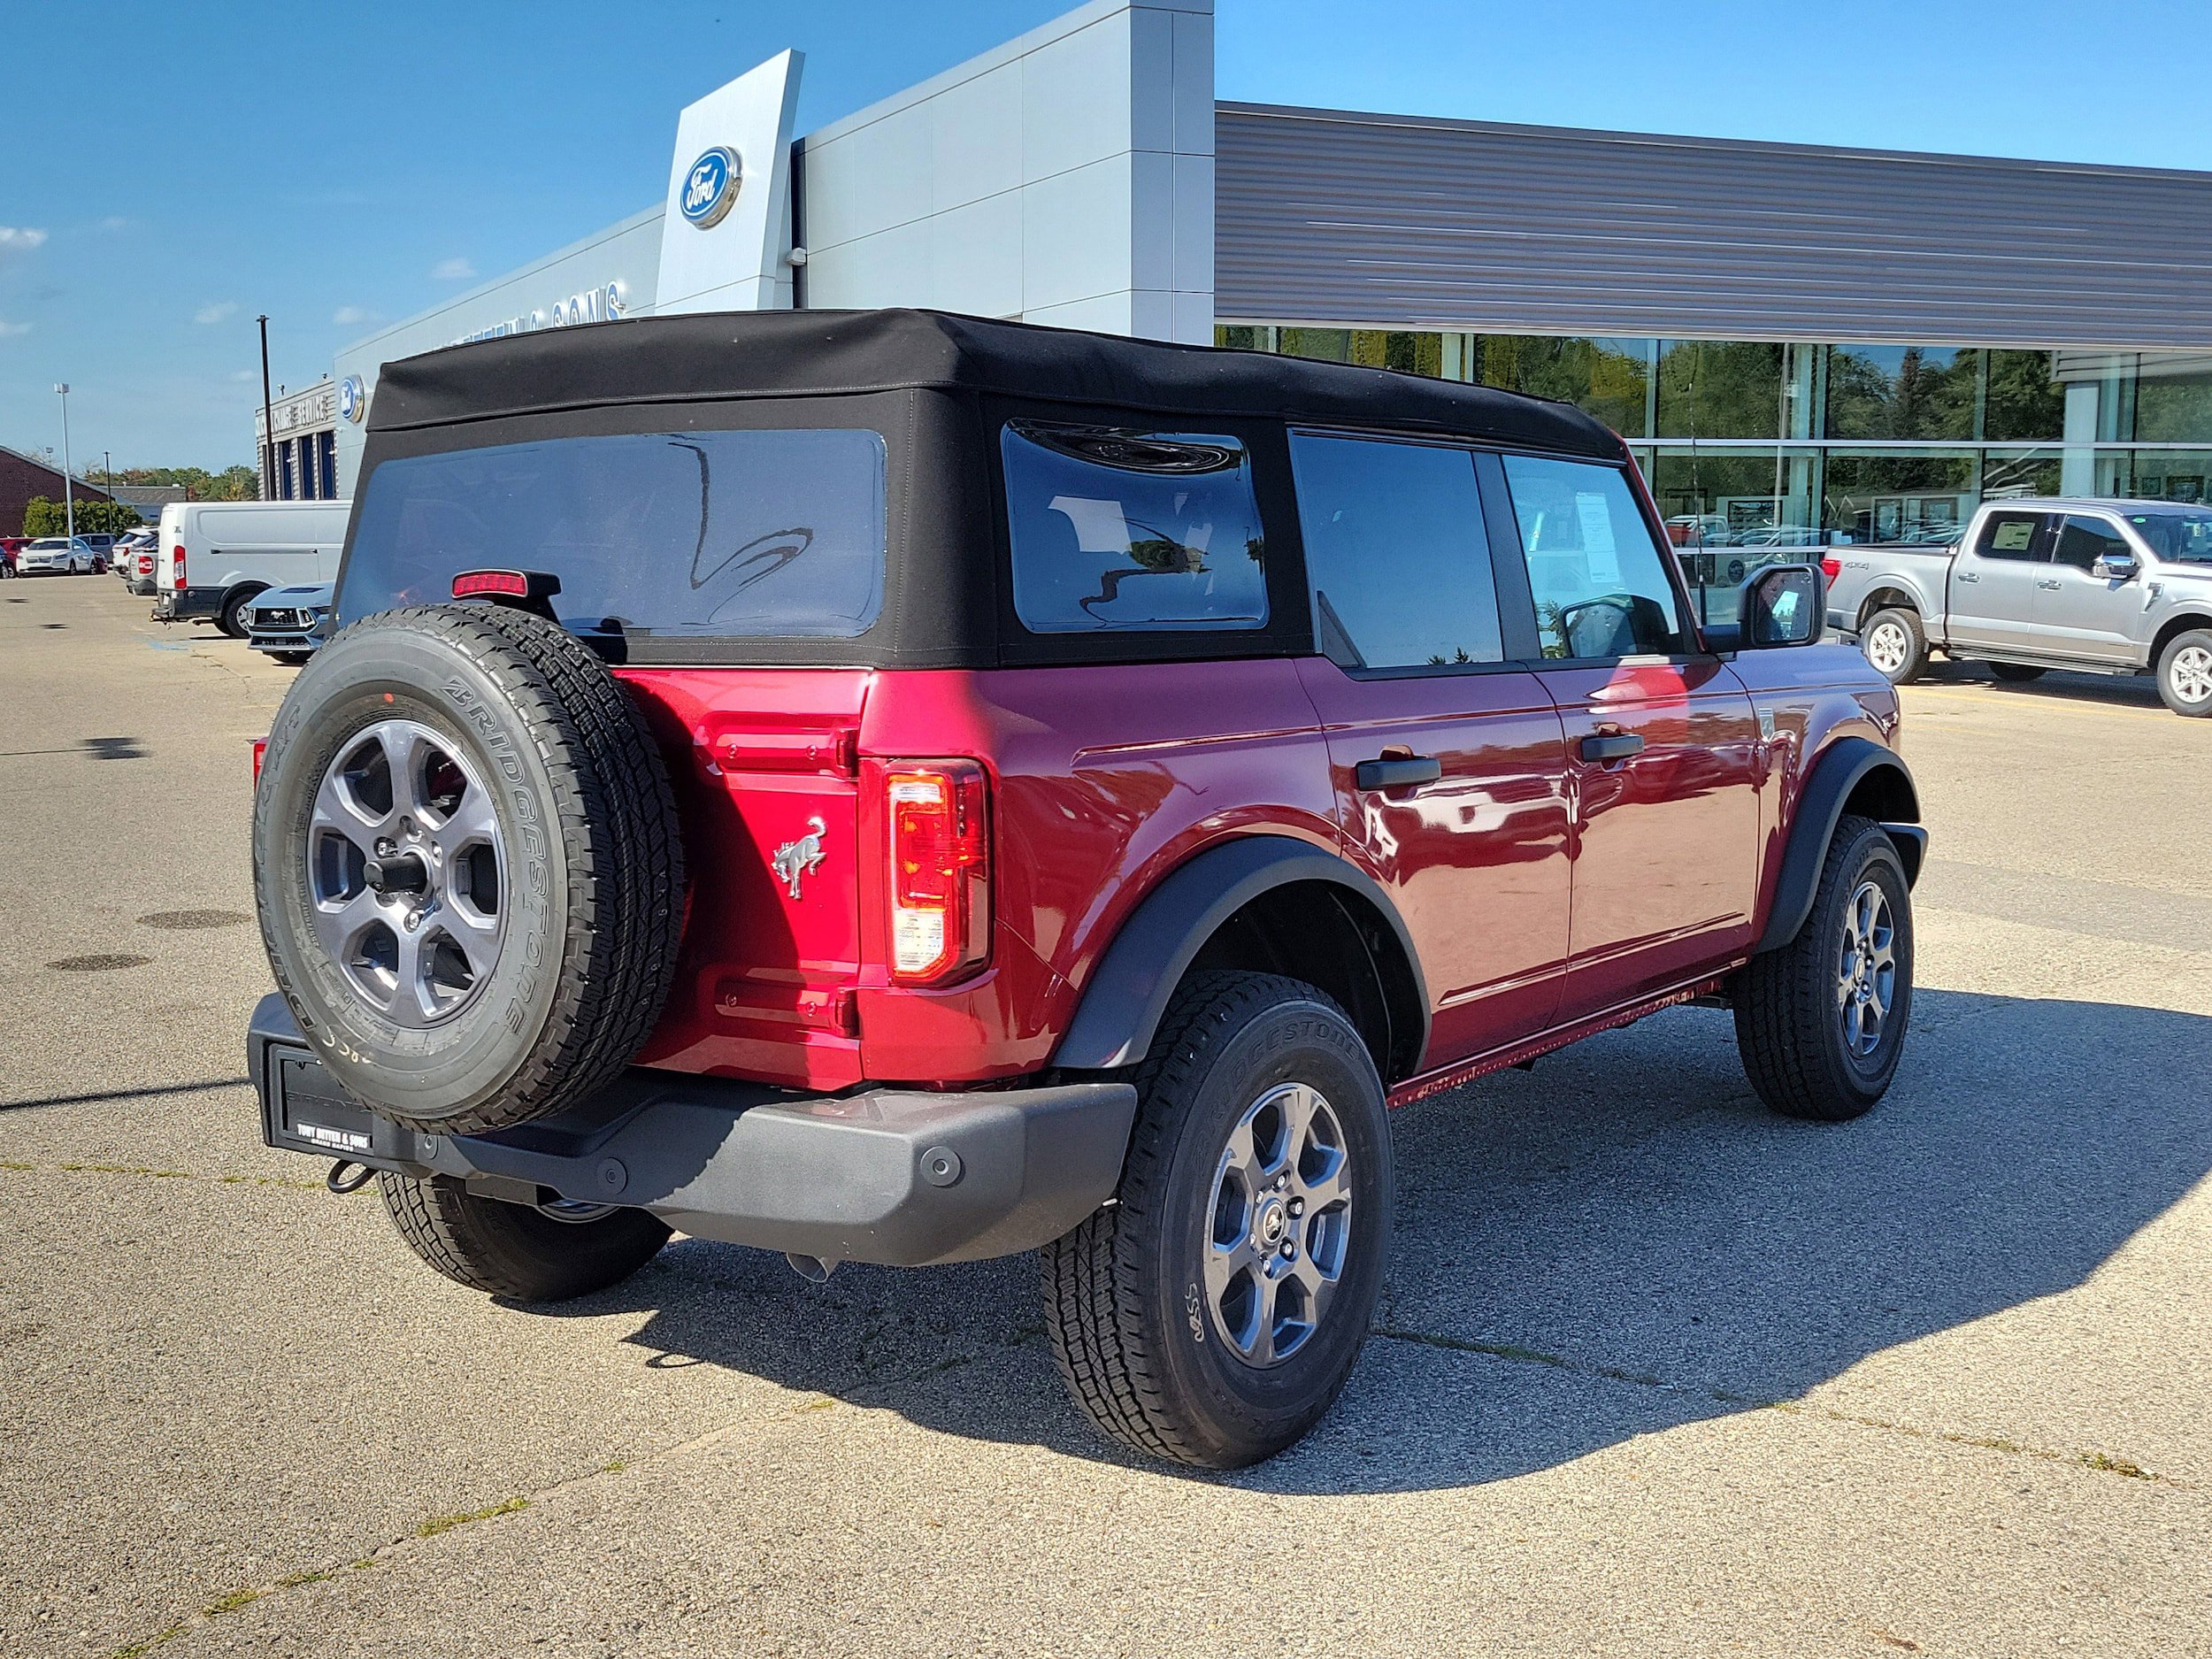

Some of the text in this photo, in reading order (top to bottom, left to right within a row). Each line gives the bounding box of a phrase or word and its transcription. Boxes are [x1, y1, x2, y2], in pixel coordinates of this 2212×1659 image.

[686, 163, 718, 209] Ford
[441, 677, 549, 1035] BRIDGESTONE
[296, 1123, 316, 1138] TONY
[349, 1134, 368, 1148] SONS
